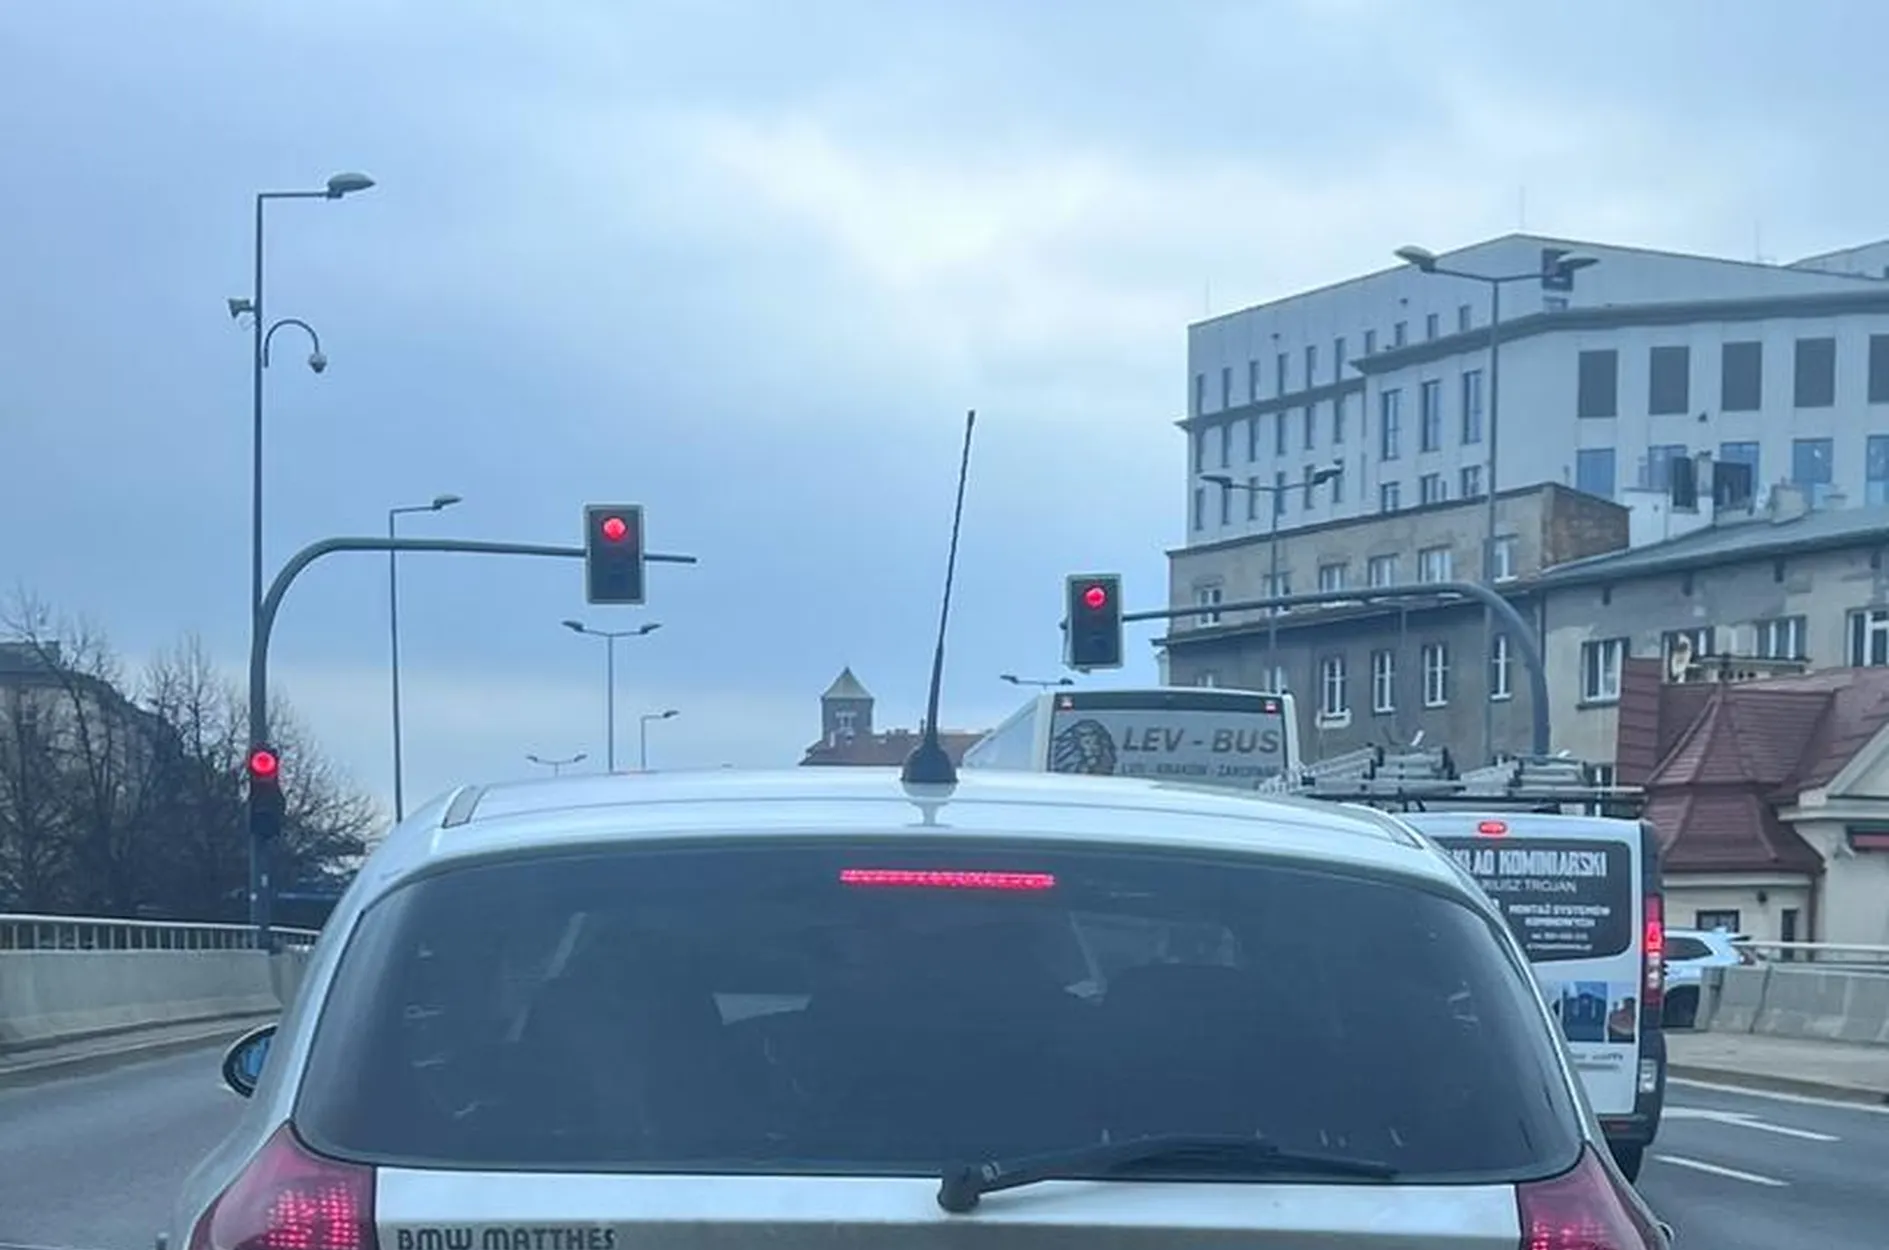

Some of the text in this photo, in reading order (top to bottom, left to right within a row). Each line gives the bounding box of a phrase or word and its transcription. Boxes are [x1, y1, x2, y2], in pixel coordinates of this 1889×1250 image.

[1122, 726, 1184, 752] LEV
[1212, 728, 1280, 754] BUS
[1499, 850, 1608, 877] KOMINIARSKI
[1523, 879, 1577, 895] TROJAN
